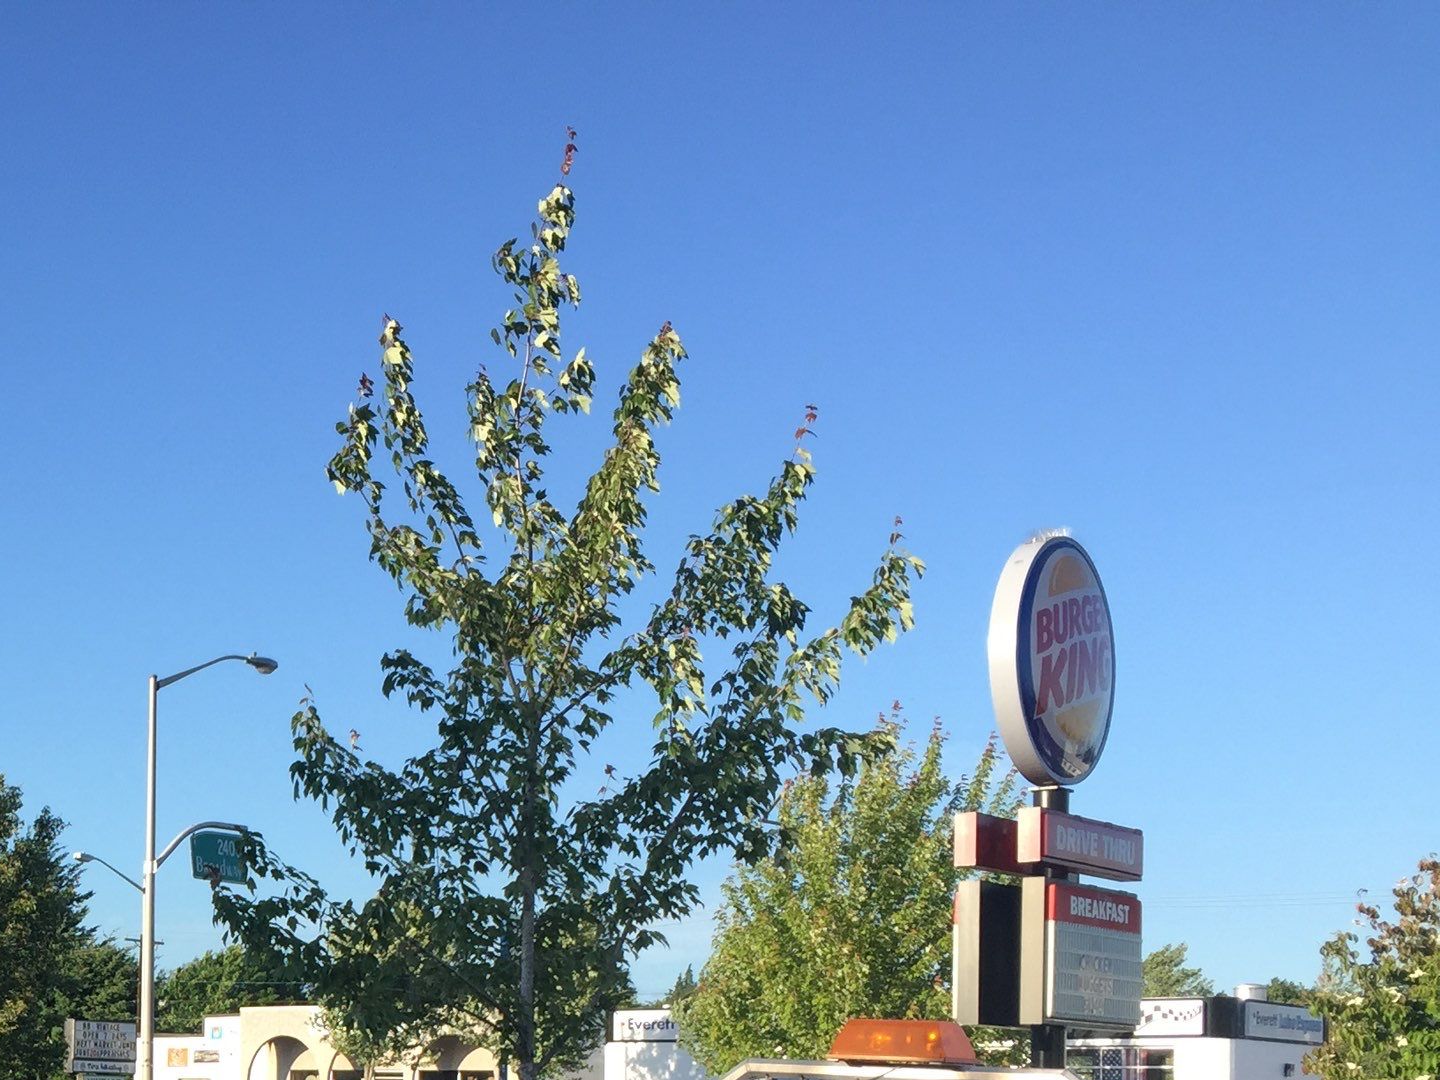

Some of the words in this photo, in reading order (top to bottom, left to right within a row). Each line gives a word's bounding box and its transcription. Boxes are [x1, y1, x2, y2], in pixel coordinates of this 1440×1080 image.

[1035, 636, 1111, 717] KING
[216, 839, 240, 858] 240
[1056, 824, 1098, 857] DRIVE
[1103, 834, 1135, 865] THRU
[1070, 895, 1130, 924] BREAKFAST
